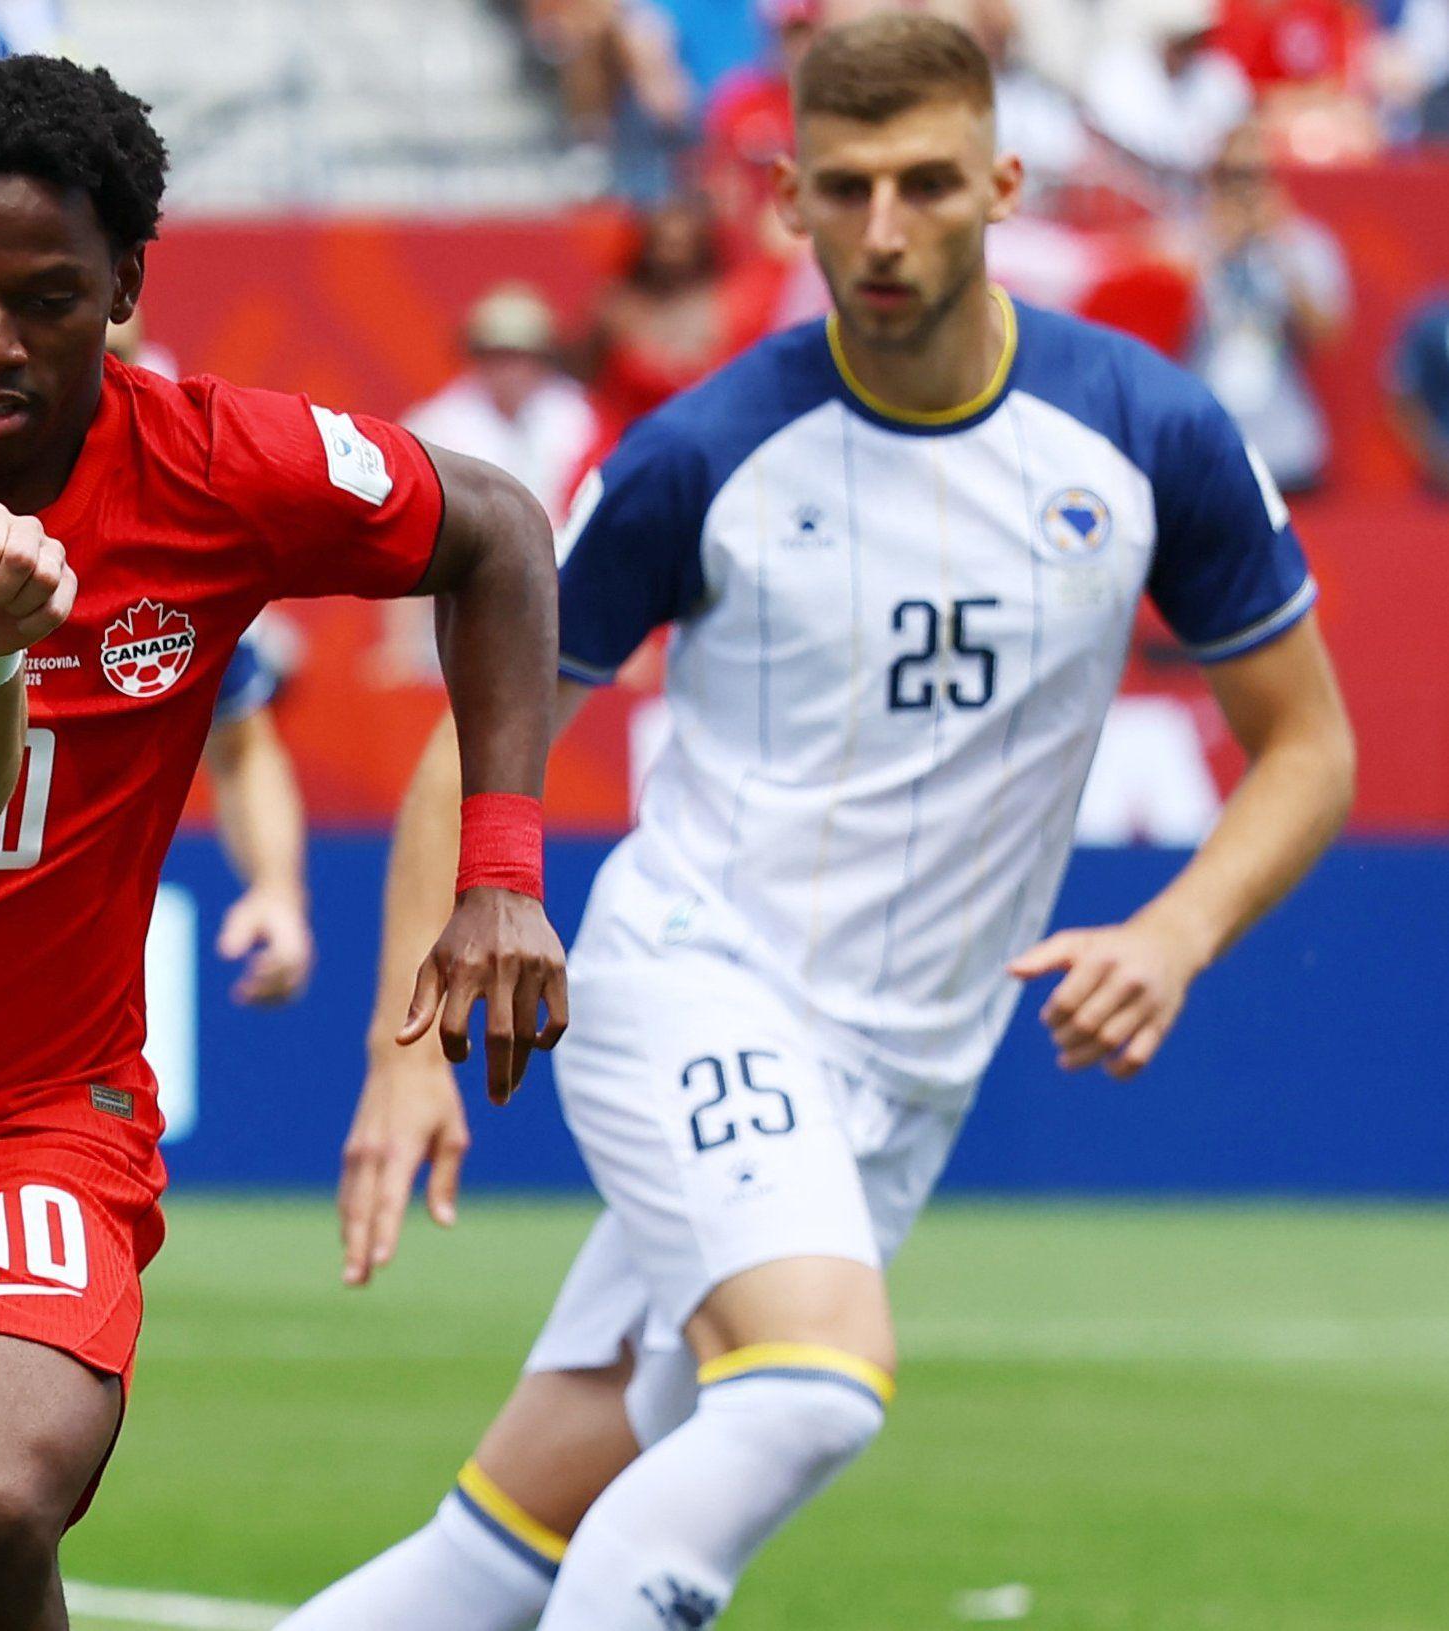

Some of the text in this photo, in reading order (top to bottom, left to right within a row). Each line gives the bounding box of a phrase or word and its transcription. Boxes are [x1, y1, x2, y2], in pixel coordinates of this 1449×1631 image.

[23, 655, 81, 670] RZEGOVINA
[103, 635, 192, 665] CANADA
[888, 598, 1000, 710] 25
[24, 673, 42, 686] 026
[681, 1052, 795, 1152] 25
